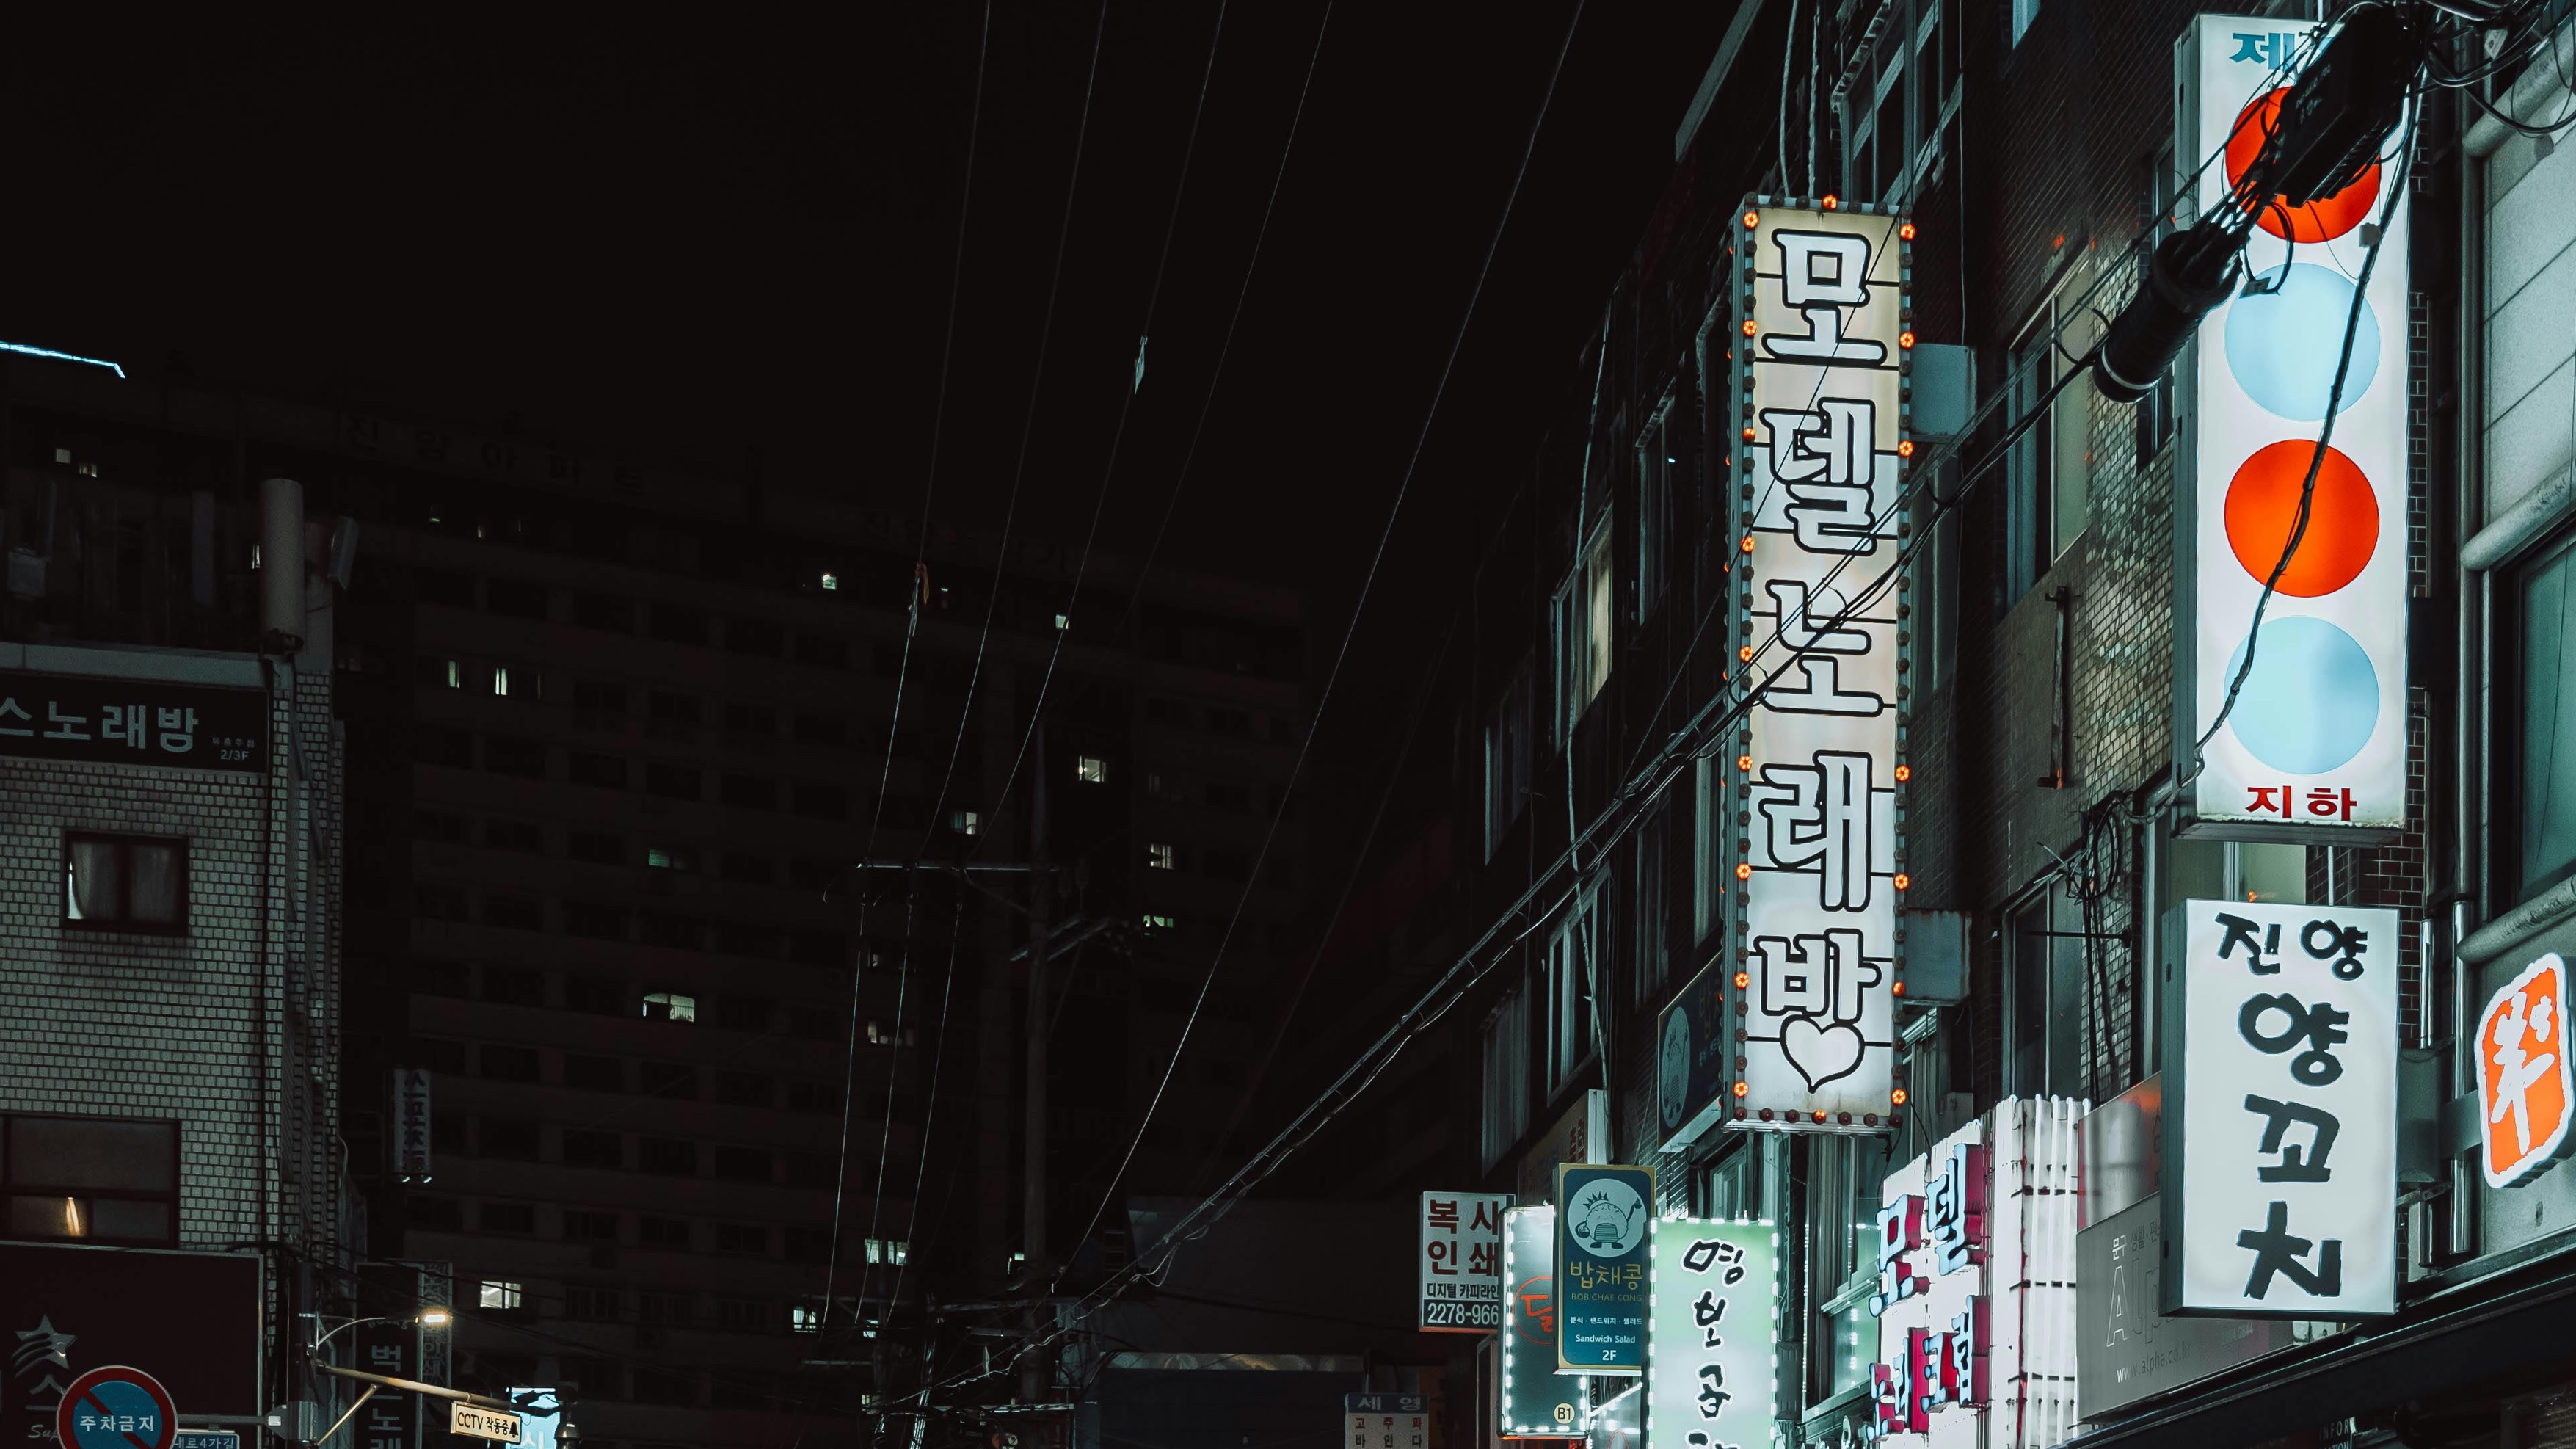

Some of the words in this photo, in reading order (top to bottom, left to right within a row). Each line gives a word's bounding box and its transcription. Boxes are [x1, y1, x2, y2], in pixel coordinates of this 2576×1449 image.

[0, 697, 200, 753] 스노래방
[220, 749, 250, 760] 2/3F
[2245, 785, 2357, 822] 지하
[2214, 912, 2369, 981] 진양
[2236, 992, 2349, 1300] 양꼬치
[1427, 1199, 1499, 1235] 복사
[1427, 1241, 1499, 1277] 인쇄
[1570, 1260, 1643, 1290] 밥채콩
[1427, 1282, 1457, 1299] 디지털
[1575, 1334, 1612, 1343] Sandwich
[1615, 1334, 1636, 1343] Salad
[1601, 1349, 1617, 1361] 2F
[1357, 1396, 1422, 1412] 세영
[1557, 1407, 1571, 1420] B1
[80, 1414, 156, 1432] 주차금지
[457, 1412, 484, 1430] CCTV
[486, 1416, 509, 1435] 작동중
